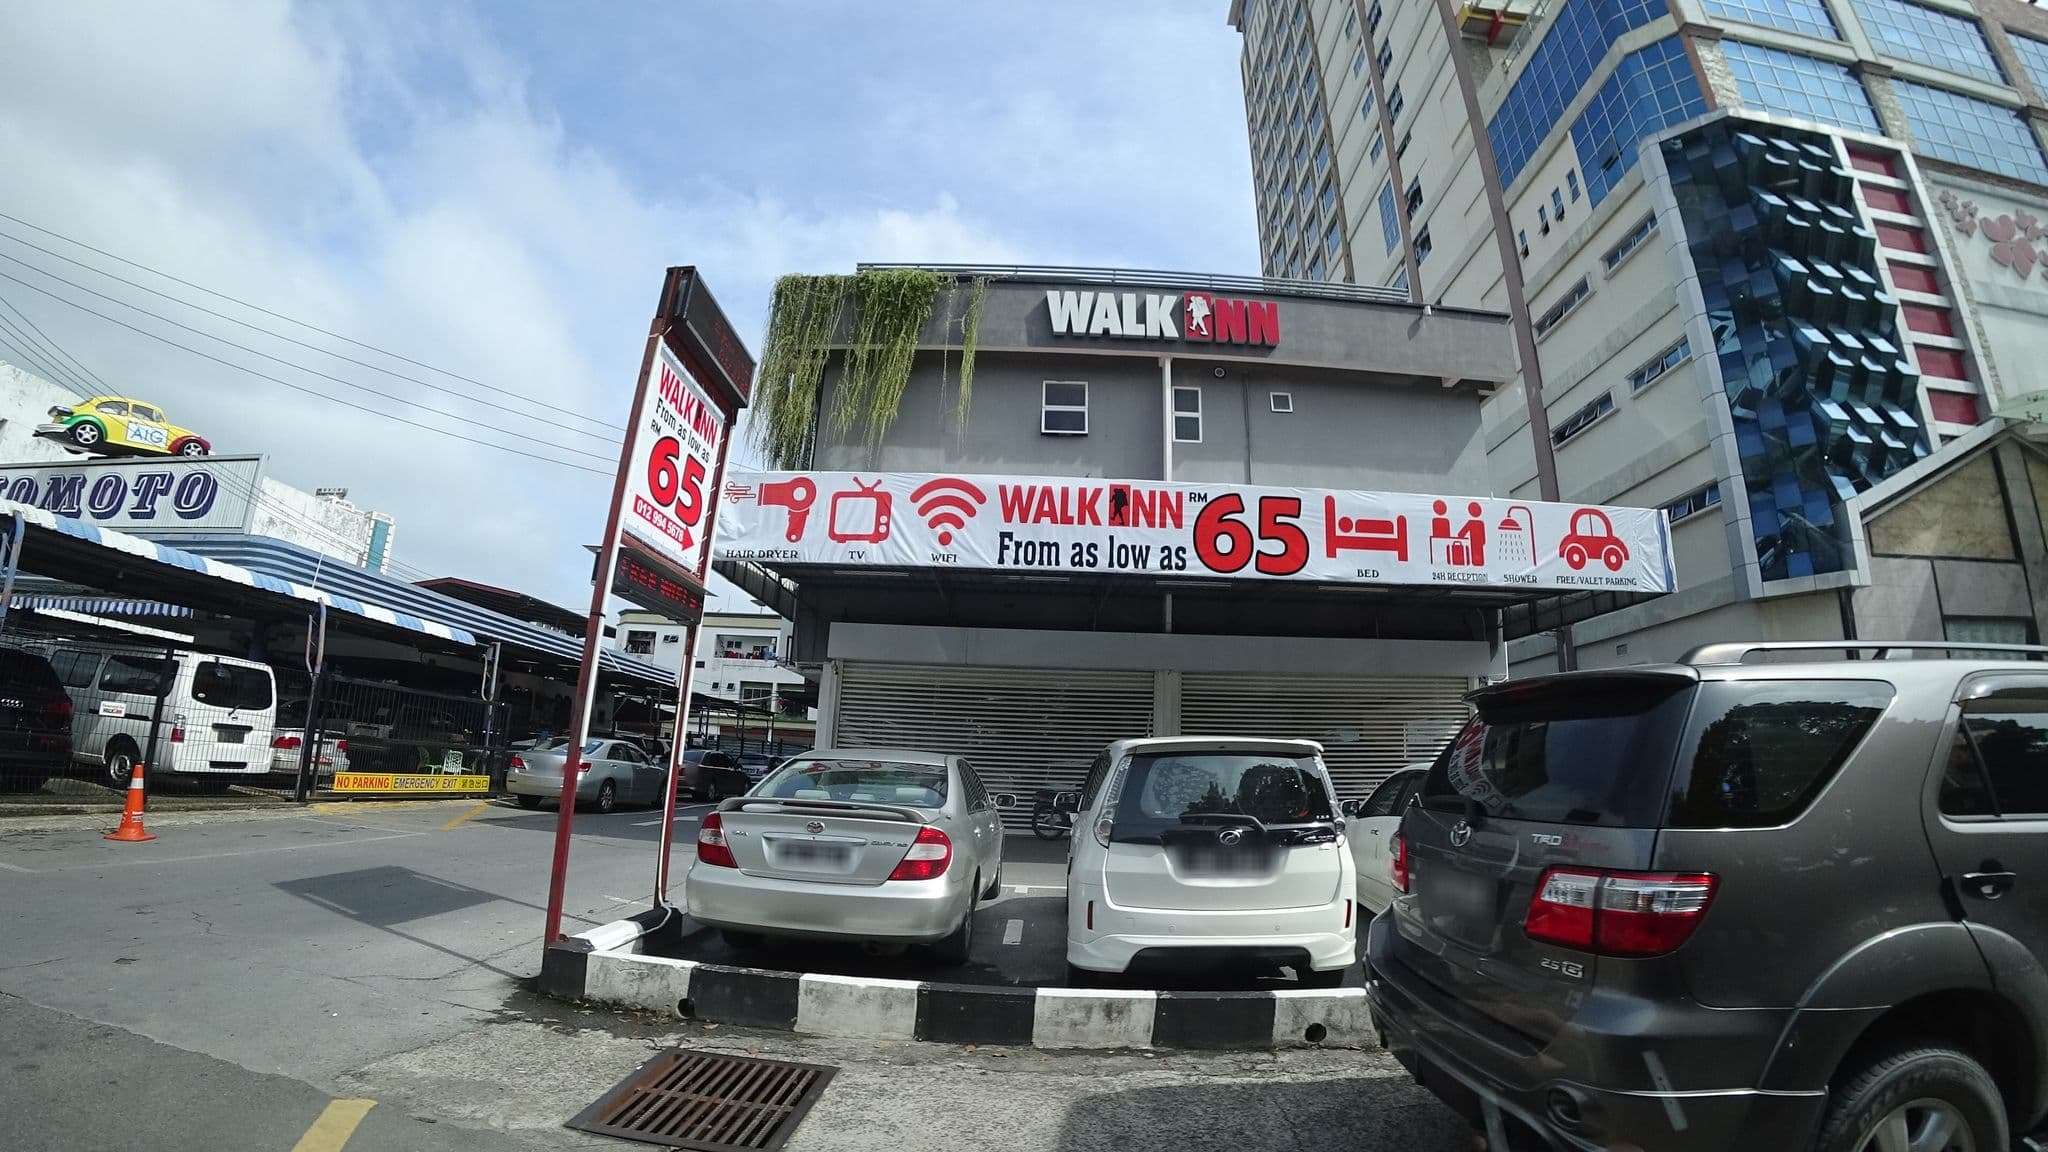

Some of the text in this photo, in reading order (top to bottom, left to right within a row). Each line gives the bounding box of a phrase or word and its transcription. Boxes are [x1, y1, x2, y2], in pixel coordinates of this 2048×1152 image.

[1046, 290, 1180, 340] WALK
[660, 361, 696, 425] WALK
[650, 419, 661, 436] RM
[656, 397, 710, 463] From as low as
[648, 436, 706, 527] 65
[0, 471, 218, 520] OMOTO
[636, 499, 652, 521] 012
[998, 484, 1104, 527] WALK
[1189, 492, 1310, 576] RM 65
[725, 549, 799, 560] HAIR DRYER
[848, 550, 866, 560] TV
[931, 552, 958, 563] WIFI
[997, 531, 1187, 571] From as low as
[1356, 568, 1379, 579] BED
[1432, 572, 1446, 581] 24H
[1503, 574, 1538, 584] SHOWER
[1605, 577, 1637, 586] PARKING
[336, 776, 390, 789] NO PARKING
[393, 777, 458, 789] EMERGENCY EXIT
